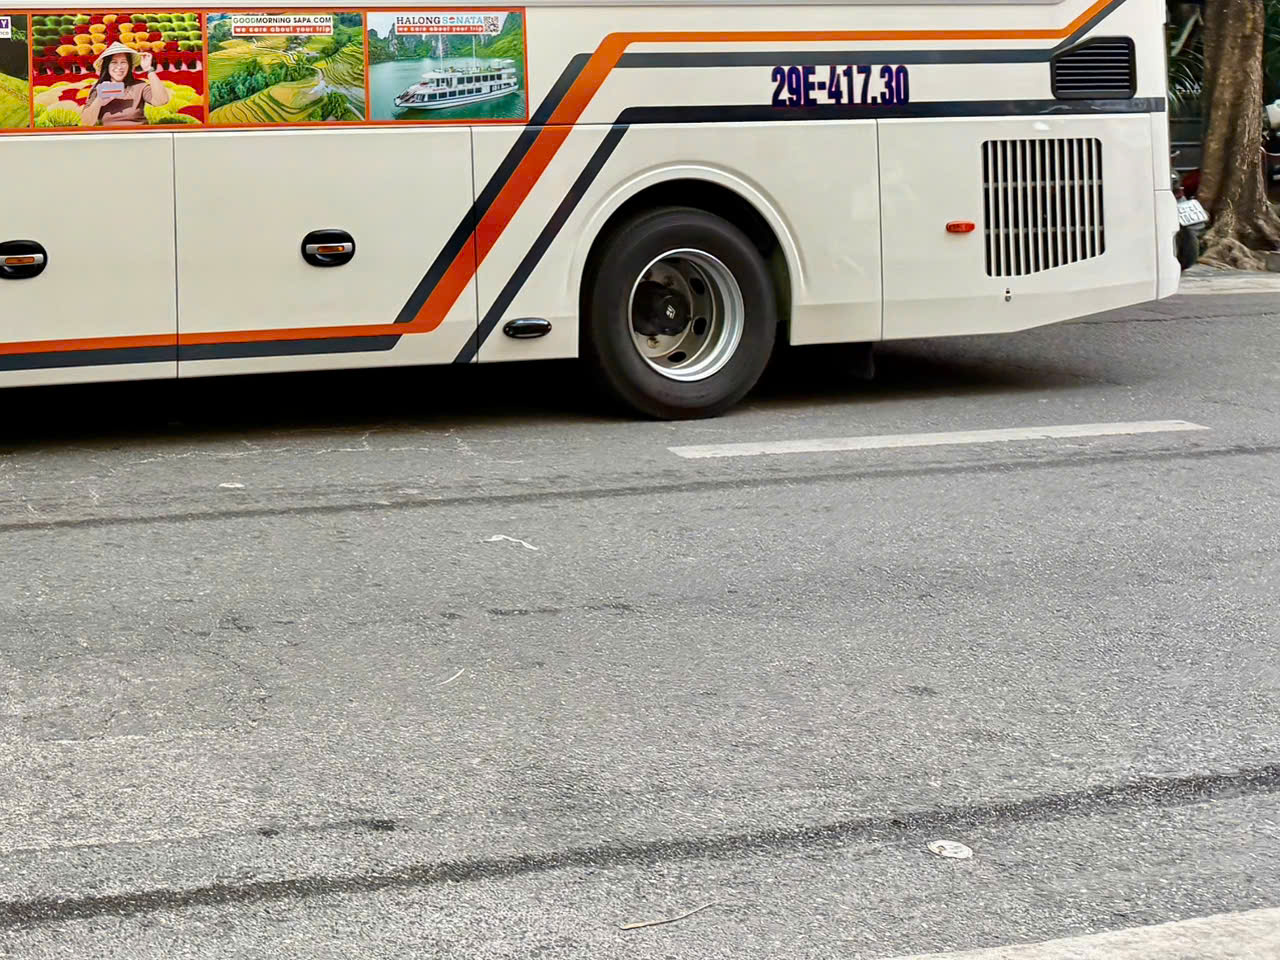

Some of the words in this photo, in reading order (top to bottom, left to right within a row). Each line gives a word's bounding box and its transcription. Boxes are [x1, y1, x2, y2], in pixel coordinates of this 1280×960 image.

[232, 16, 292, 25] GOODMORNING
[396, 16, 441, 25] HALONG
[441, 16, 484, 25] SONATA
[270, 25, 294, 33] about
[295, 26, 314, 34] your
[315, 25, 332, 34] trip
[771, 64, 910, 108] 29E-417.30
